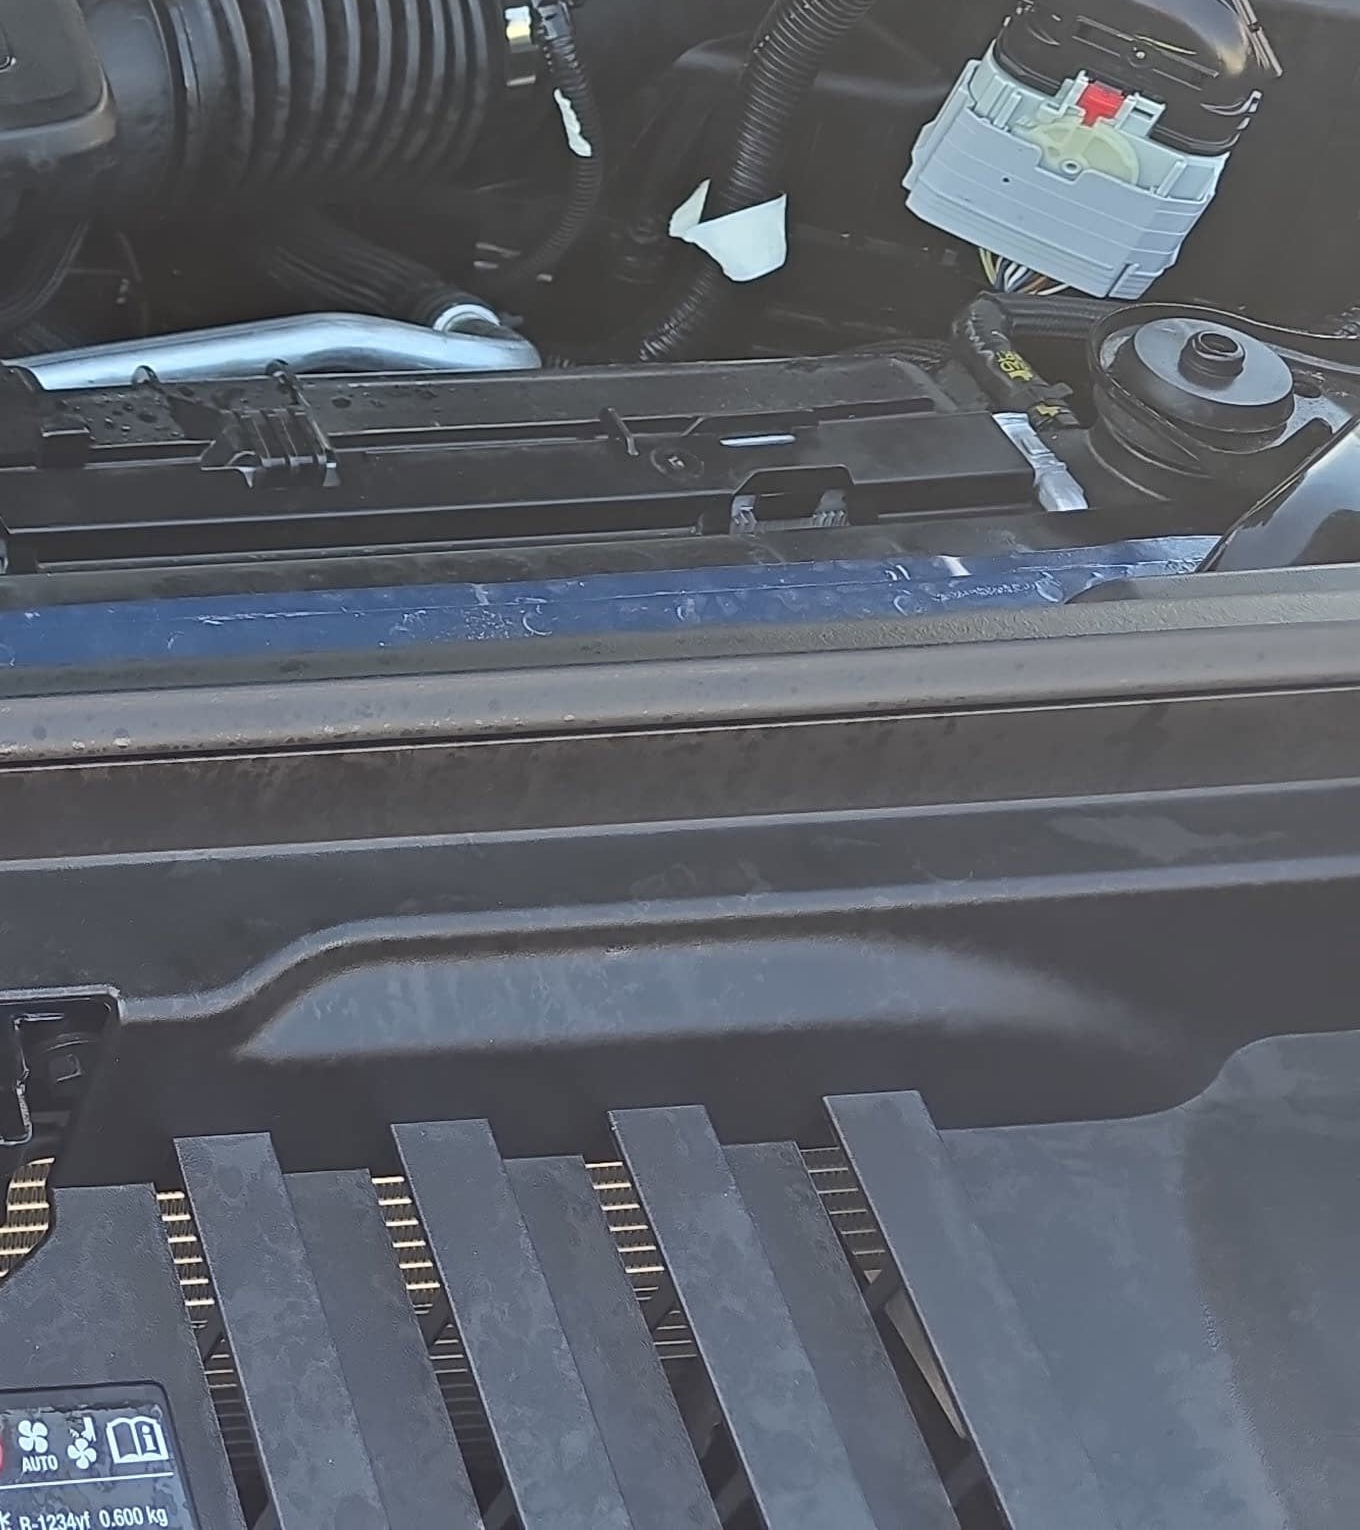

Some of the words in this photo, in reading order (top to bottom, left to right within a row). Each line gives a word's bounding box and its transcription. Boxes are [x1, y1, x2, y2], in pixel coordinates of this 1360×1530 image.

[22, 1454, 59, 1473] AUTO
[98, 1506, 144, 1528] 0.600
[146, 1505, 169, 1527] kg
